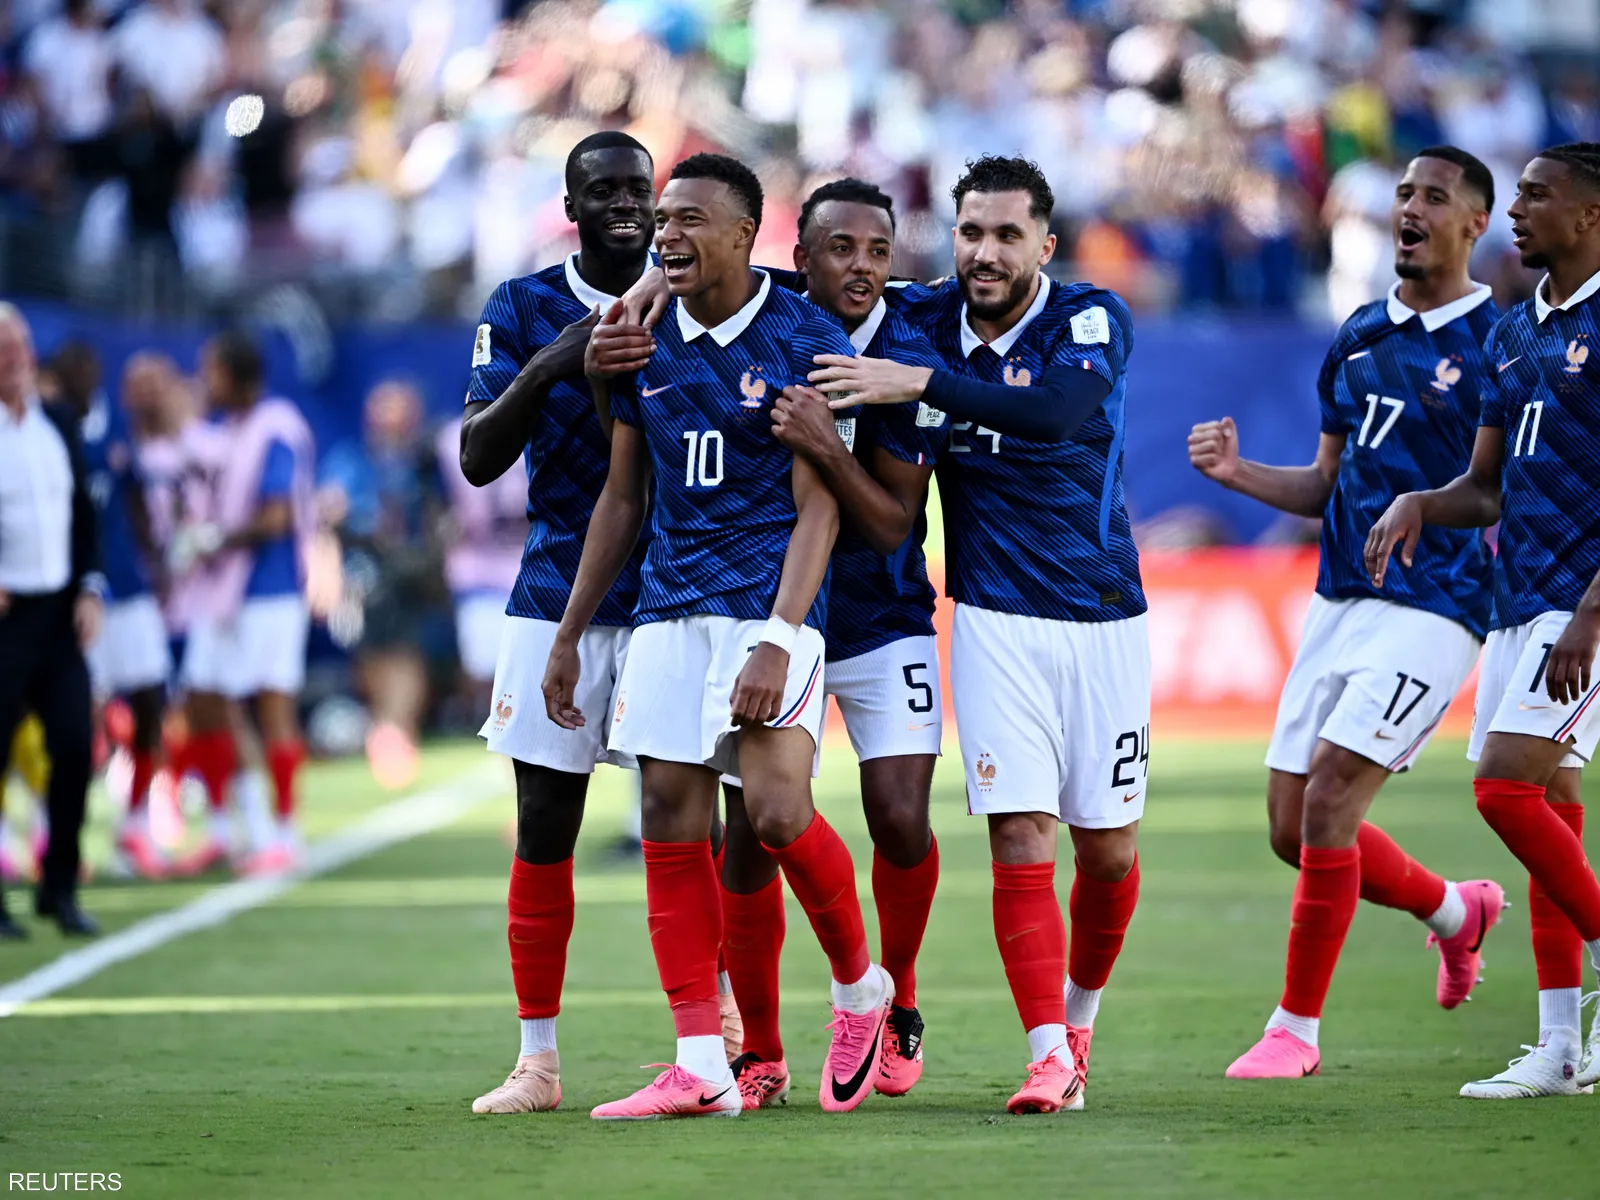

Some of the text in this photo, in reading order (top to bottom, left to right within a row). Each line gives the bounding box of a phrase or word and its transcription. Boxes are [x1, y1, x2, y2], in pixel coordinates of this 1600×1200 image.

[835, 425, 852, 436] ITES
[926, 411, 940, 419] PEACE
[1357, 393, 1406, 449] 17
[1514, 400, 1543, 457] 11
[683, 430, 724, 487] 10
[902, 663, 933, 713] 5
[1529, 642, 1555, 693] 1
[1382, 671, 1431, 727] 17
[1111, 722, 1150, 789] 24
